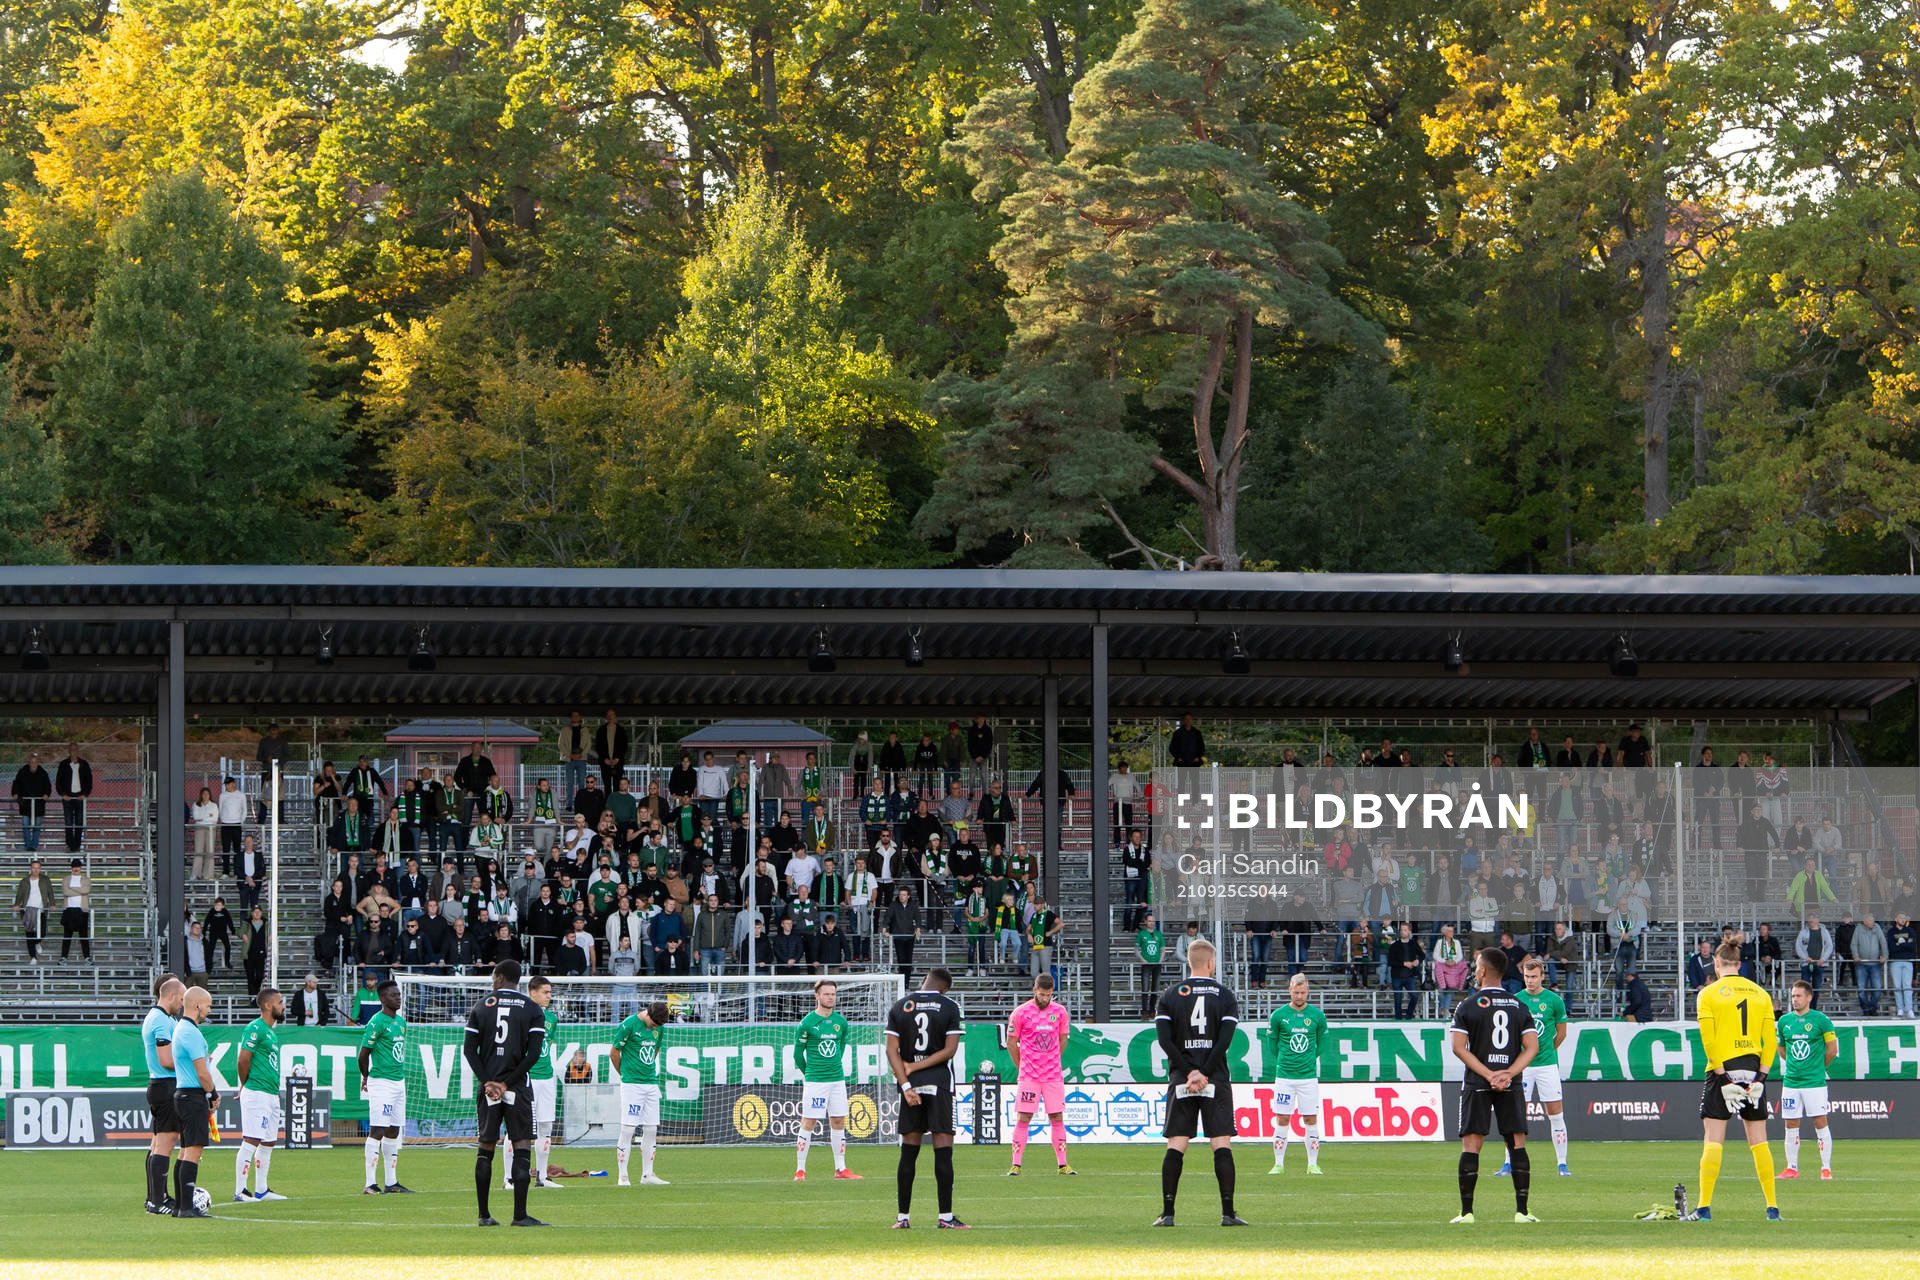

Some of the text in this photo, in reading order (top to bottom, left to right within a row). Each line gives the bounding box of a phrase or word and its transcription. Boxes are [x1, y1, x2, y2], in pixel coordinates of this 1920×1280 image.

[494, 1007, 510, 1044] 5
[914, 1012, 929, 1051] 3
[1190, 995, 1207, 1035] 4
[1491, 1010, 1509, 1050] 8
[1736, 998, 1748, 1036] 1
[13, 1096, 95, 1144] BOA
[292, 1086, 307, 1142] SELECT
[982, 1083, 997, 1138] SELECT
[1323, 1087, 1439, 1137] habo
